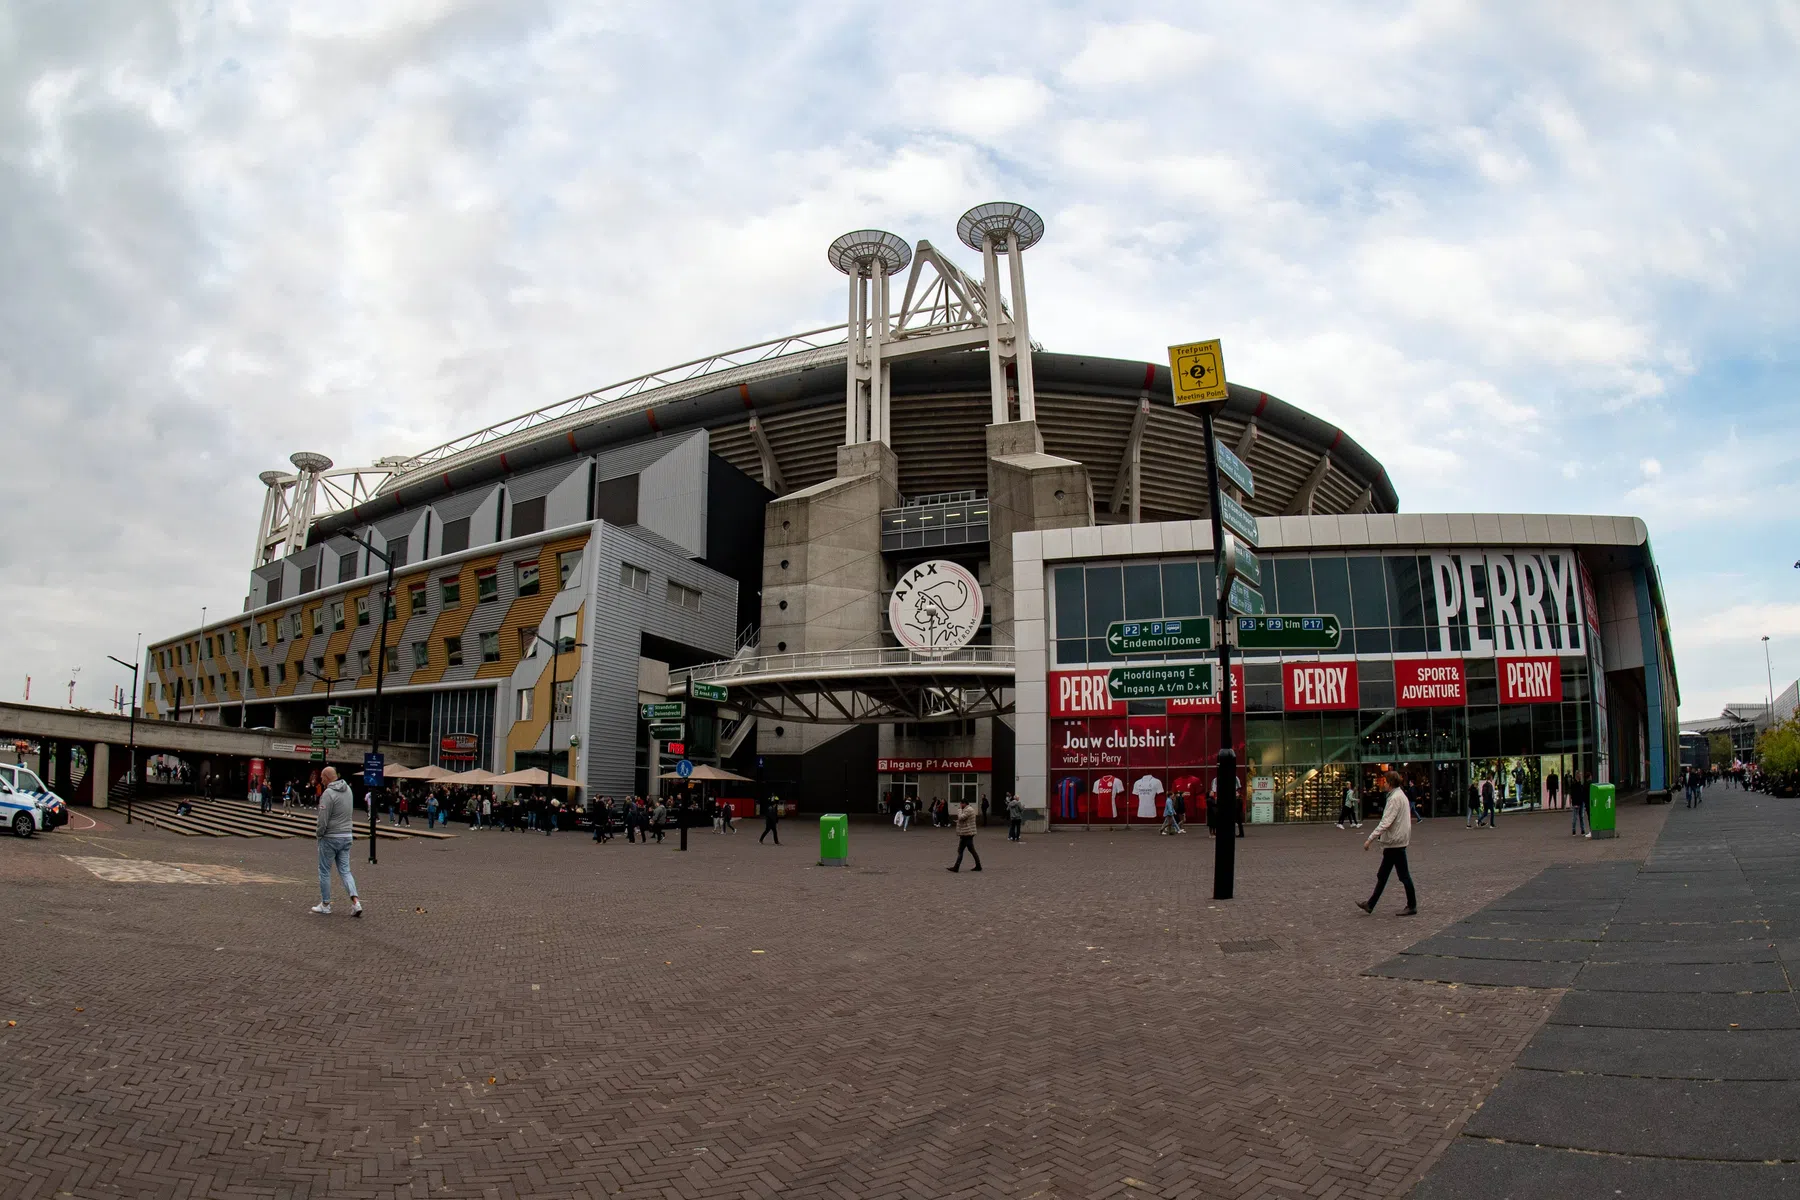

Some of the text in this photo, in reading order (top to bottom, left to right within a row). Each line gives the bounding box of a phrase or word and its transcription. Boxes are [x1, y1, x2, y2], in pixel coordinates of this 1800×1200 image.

[1177, 345, 1212, 355] Trefpunt
[1194, 367, 1202, 377] 2
[1177, 390, 1224, 401] Meeting Point
[896, 563, 938, 602] AJAX
[1430, 552, 1573, 652] PERRY
[1125, 626, 1138, 635] P2
[1154, 624, 1160, 632] P
[1241, 621, 1254, 629] P3
[1269, 621, 1281, 629] P9
[1285, 620, 1300, 629] t/m
[1123, 636, 1201, 648] Endemol/Dome
[1123, 668, 1195, 681] Hoofdingang E
[1506, 662, 1552, 698] PERRY
[1124, 685, 1155, 694] Ingang
[1167, 683, 1184, 691] t/m
[1293, 667, 1348, 705] PERRY
[1402, 684, 1461, 699] ADVENTURE
[1063, 729, 1176, 749] Jouw clubshirt
[890, 759, 973, 770] Ingang P1 ArenA
[1063, 752, 1122, 766] vind je bij Perry
